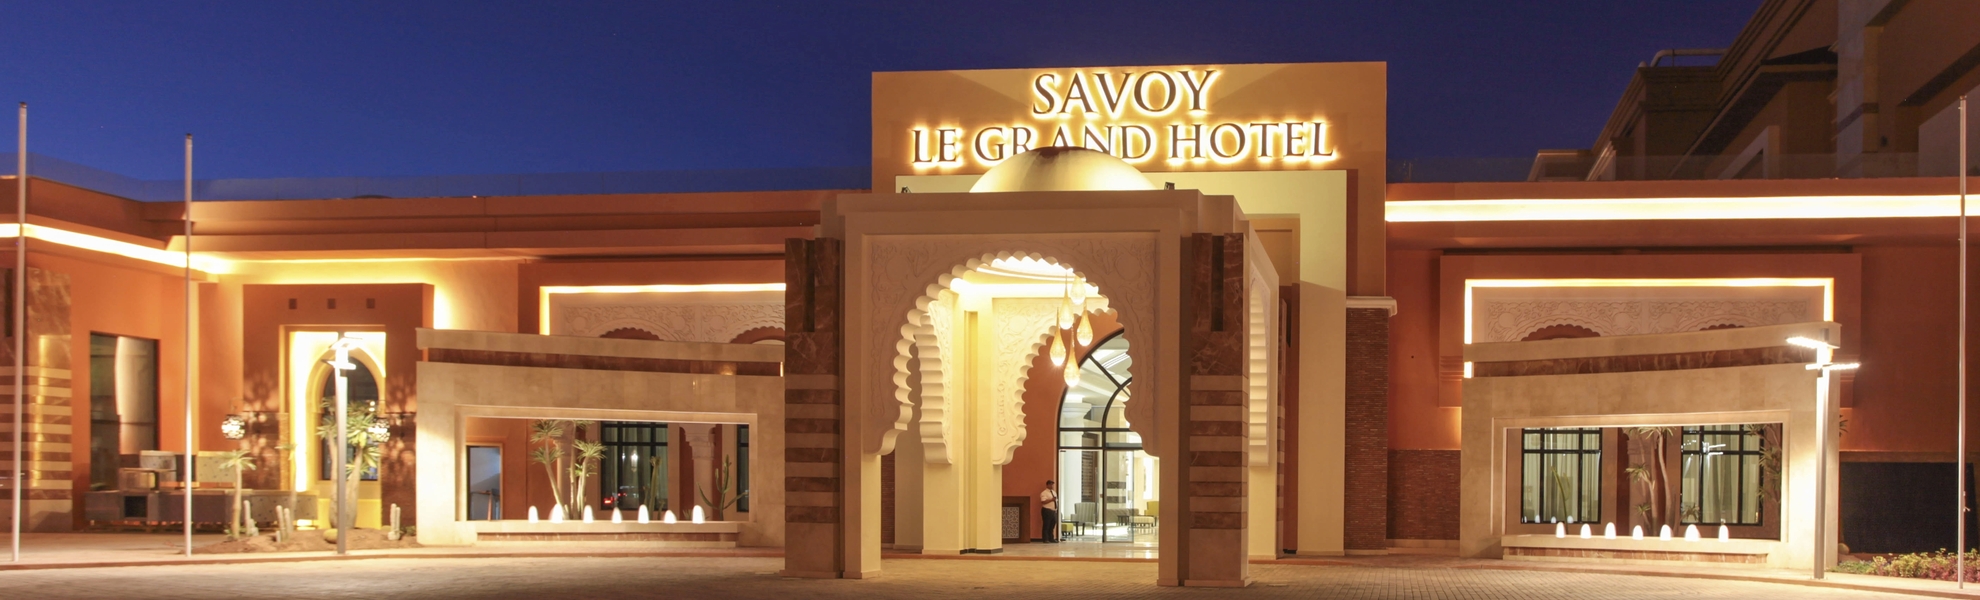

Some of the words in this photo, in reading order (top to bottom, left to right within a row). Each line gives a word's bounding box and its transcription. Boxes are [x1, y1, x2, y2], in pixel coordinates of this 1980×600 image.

[1033, 70, 1218, 115] SAVOY
[912, 128, 957, 163] LE
[975, 125, 1152, 162] GRAND
[1169, 122, 1335, 159] HOTEL
